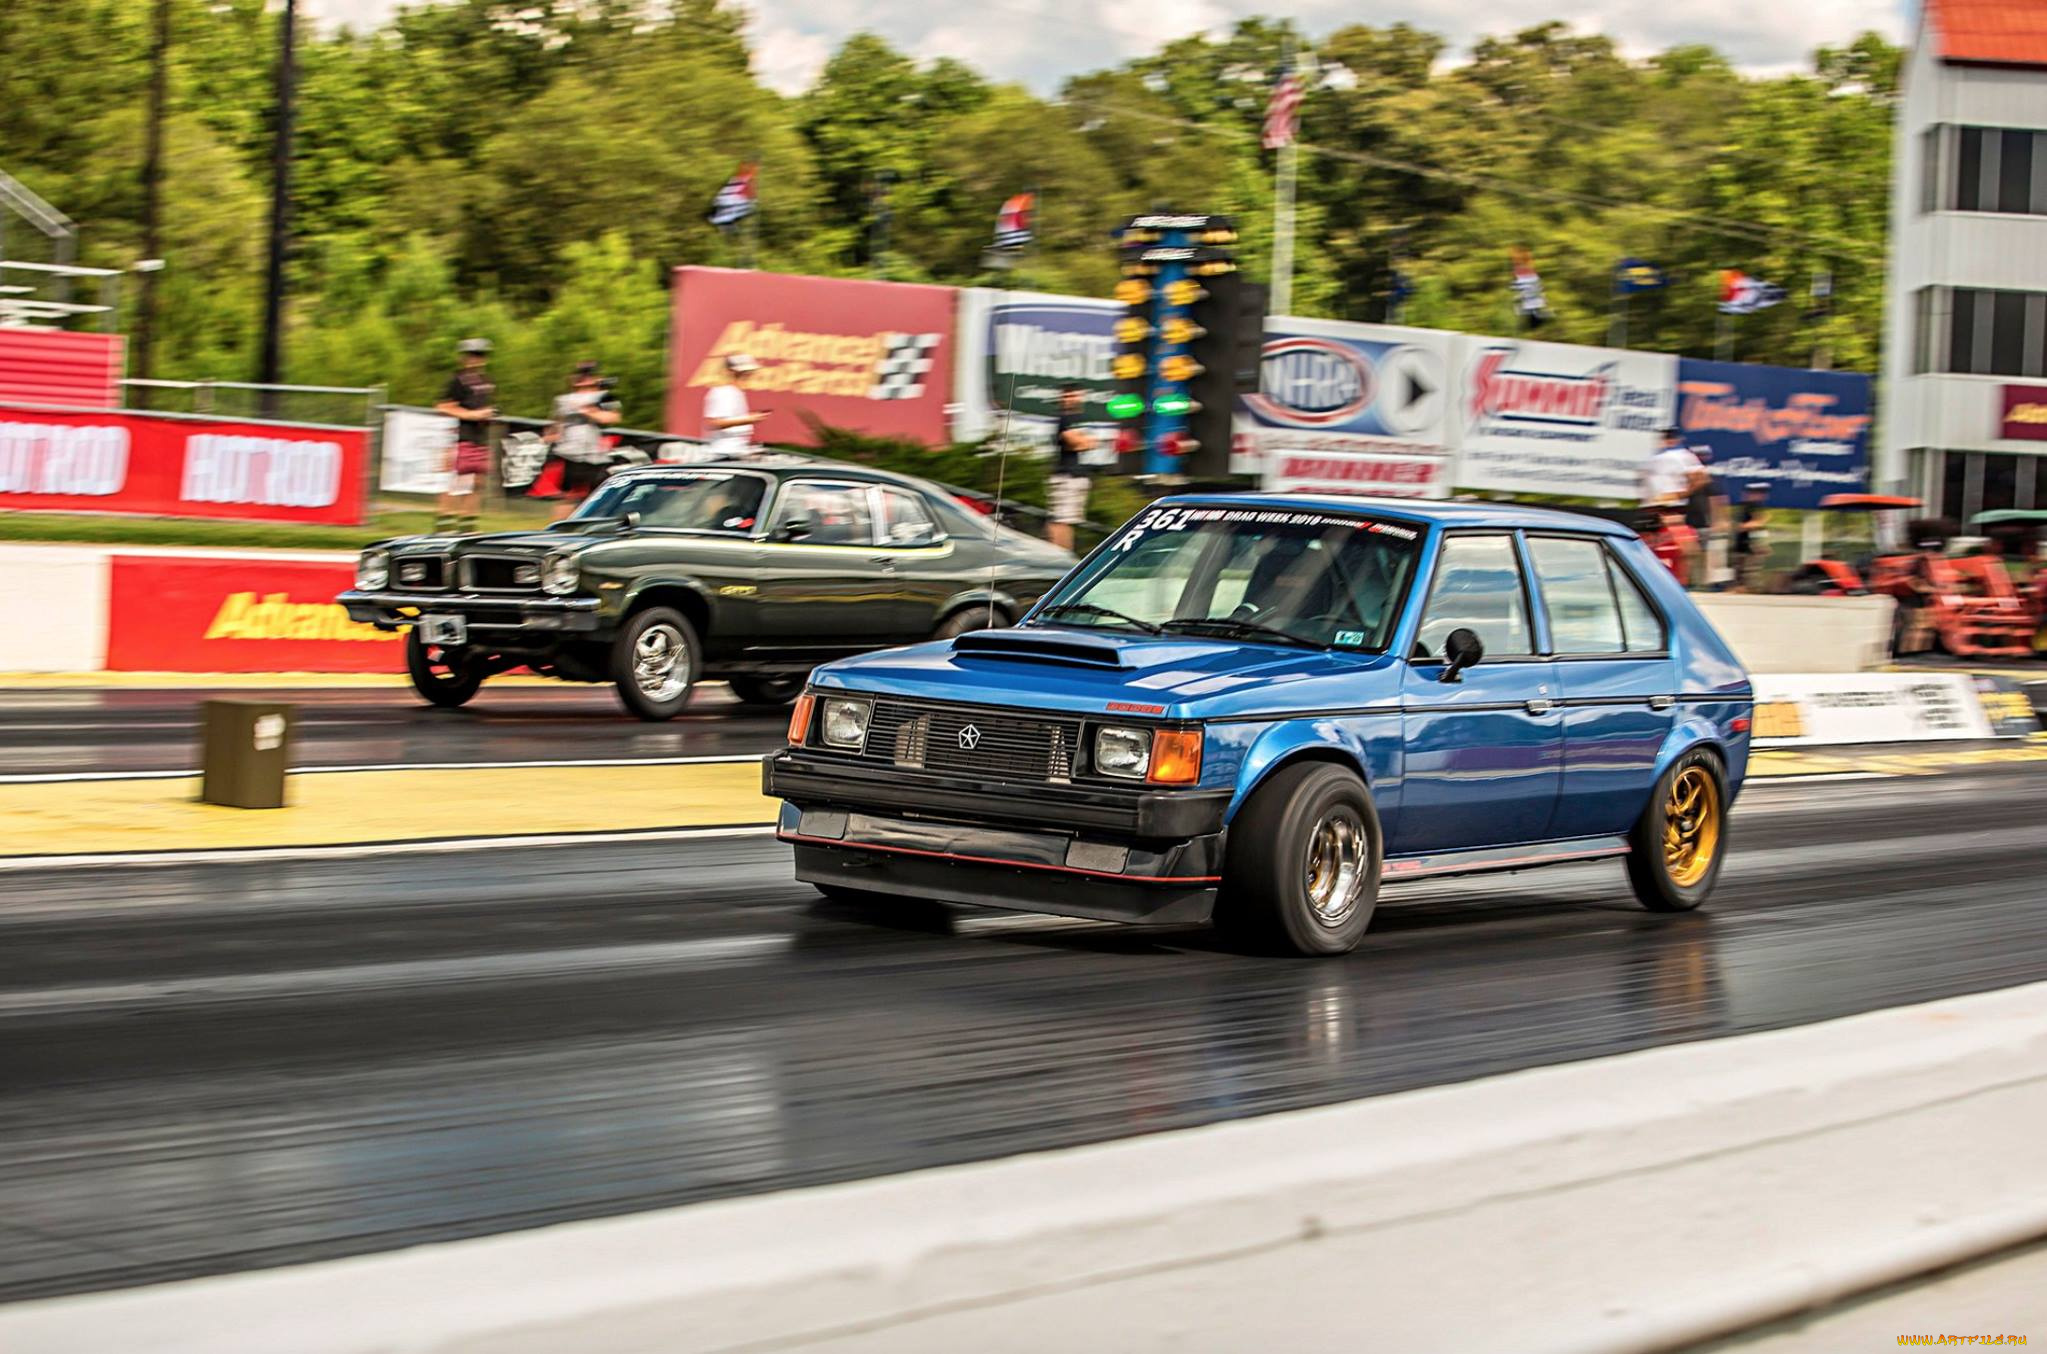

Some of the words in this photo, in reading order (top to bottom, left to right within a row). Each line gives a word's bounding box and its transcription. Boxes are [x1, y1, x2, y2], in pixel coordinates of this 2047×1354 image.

[1134, 508, 1190, 531] 361
[1256, 512, 1292, 524] WEEK
[1110, 530, 1145, 552] R
